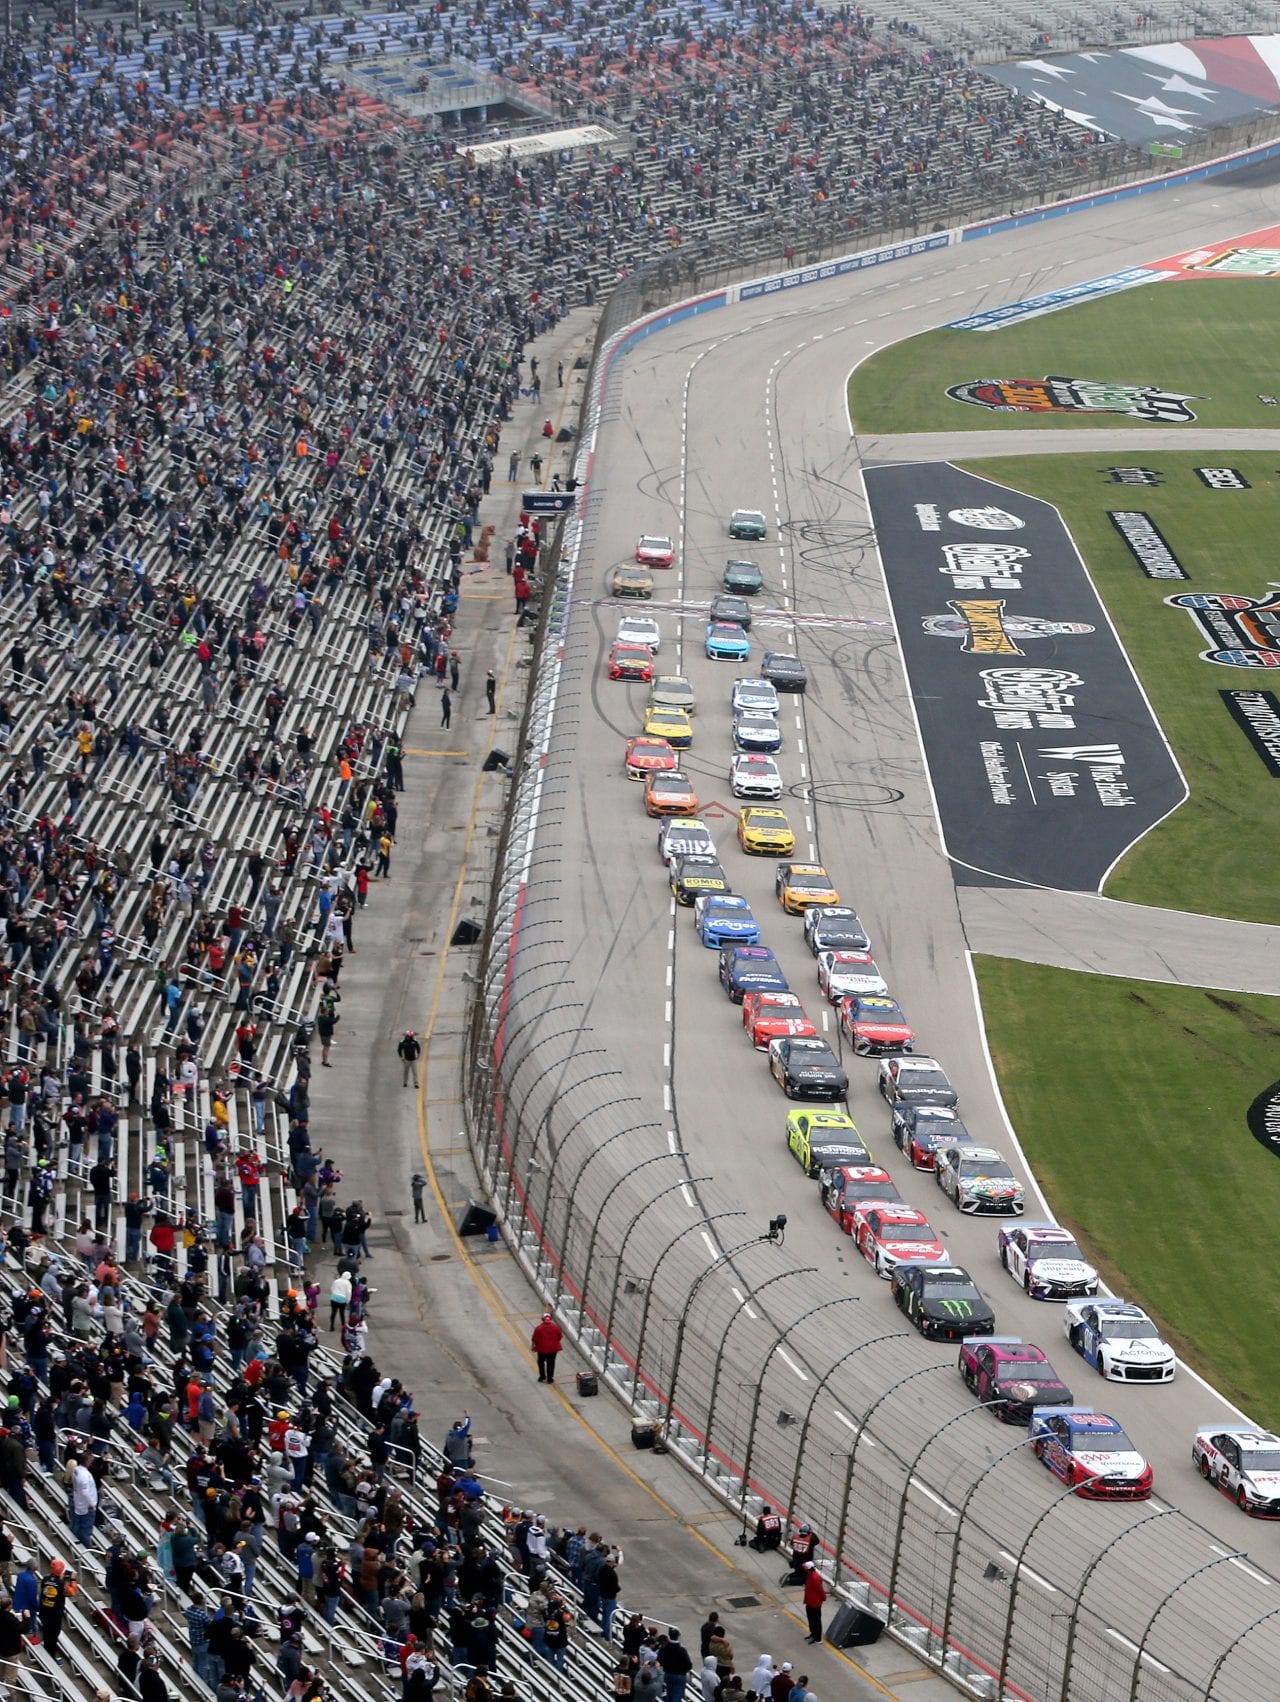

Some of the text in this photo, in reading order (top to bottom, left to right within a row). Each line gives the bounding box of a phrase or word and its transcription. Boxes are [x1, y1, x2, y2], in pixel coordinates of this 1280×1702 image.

[977, 667, 1085, 713] O'Reilly
[1037, 772, 1079, 796] System
[1089, 764, 1136, 807] Wise Health
[708, 919, 757, 931] Kroger
[812, 1146, 866, 1155] Richmond
[1120, 1349, 1167, 1357] Acronis
[1220, 1464, 1230, 1487] 2
